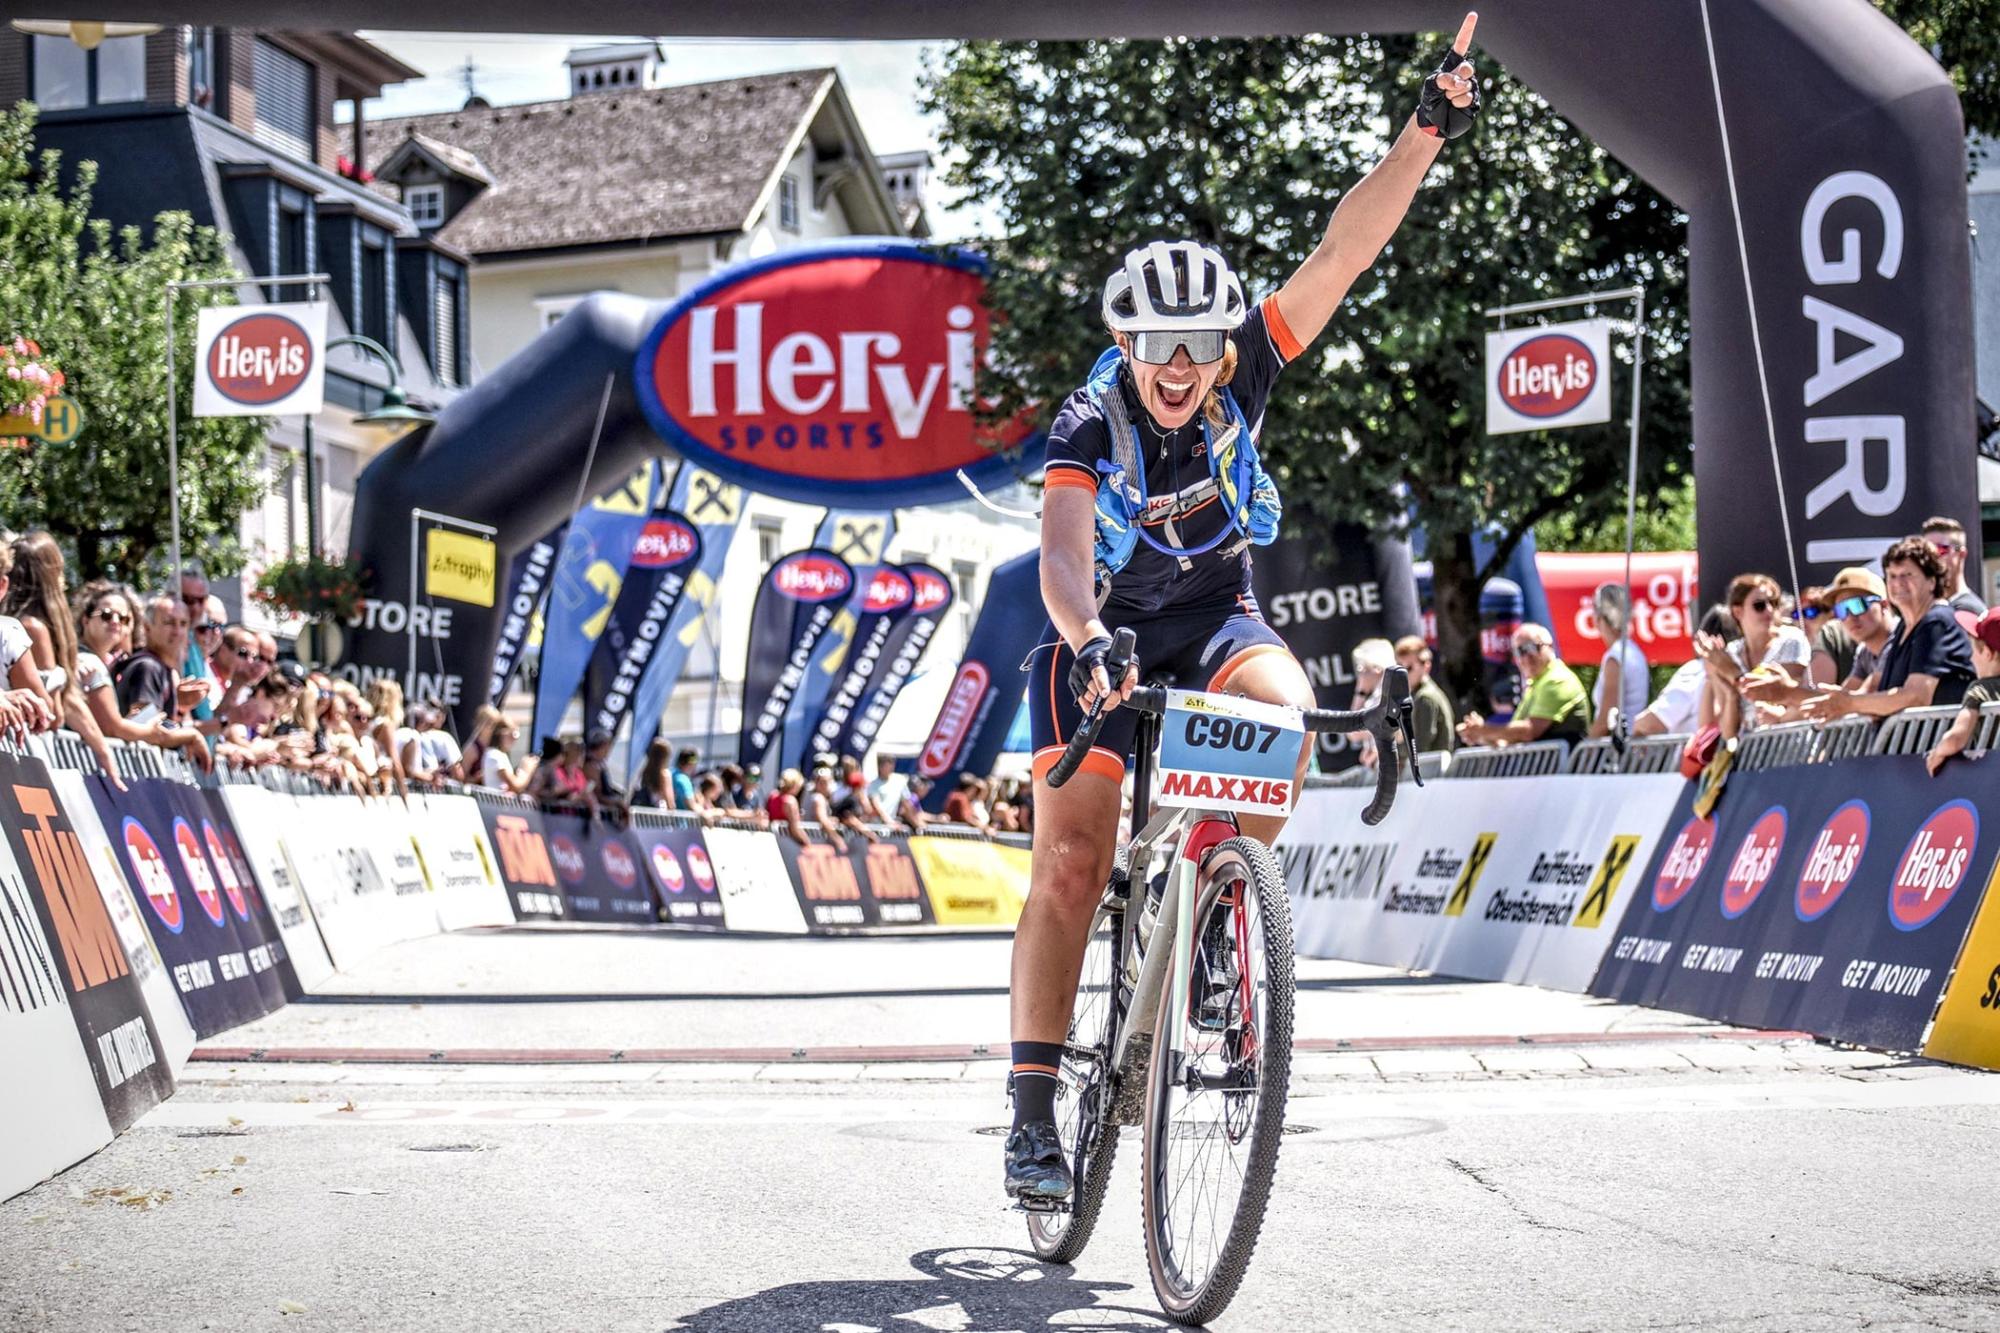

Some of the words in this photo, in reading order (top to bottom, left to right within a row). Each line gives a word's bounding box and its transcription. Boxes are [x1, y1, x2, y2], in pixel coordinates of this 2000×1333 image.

[218, 335, 305, 386] Hervis
[687, 302, 1040, 440] Hervi
[1507, 352, 1591, 400] Hervis
[45, 407, 68, 434] H
[719, 421, 884, 450] SPORTS
[632, 531, 692, 558] ervis
[1270, 582, 1382, 627] STORE
[1184, 713, 1281, 754] C907
[1161, 772, 1289, 805] MAXXIS
[1660, 833, 1709, 889] Hervis
[1729, 832, 1778, 893] Hervis
[1802, 829, 1860, 894] Hervis
[1896, 830, 1967, 901] Hervis
[1755, 952, 1783, 978] GET
[1841, 959, 1877, 989] GET
